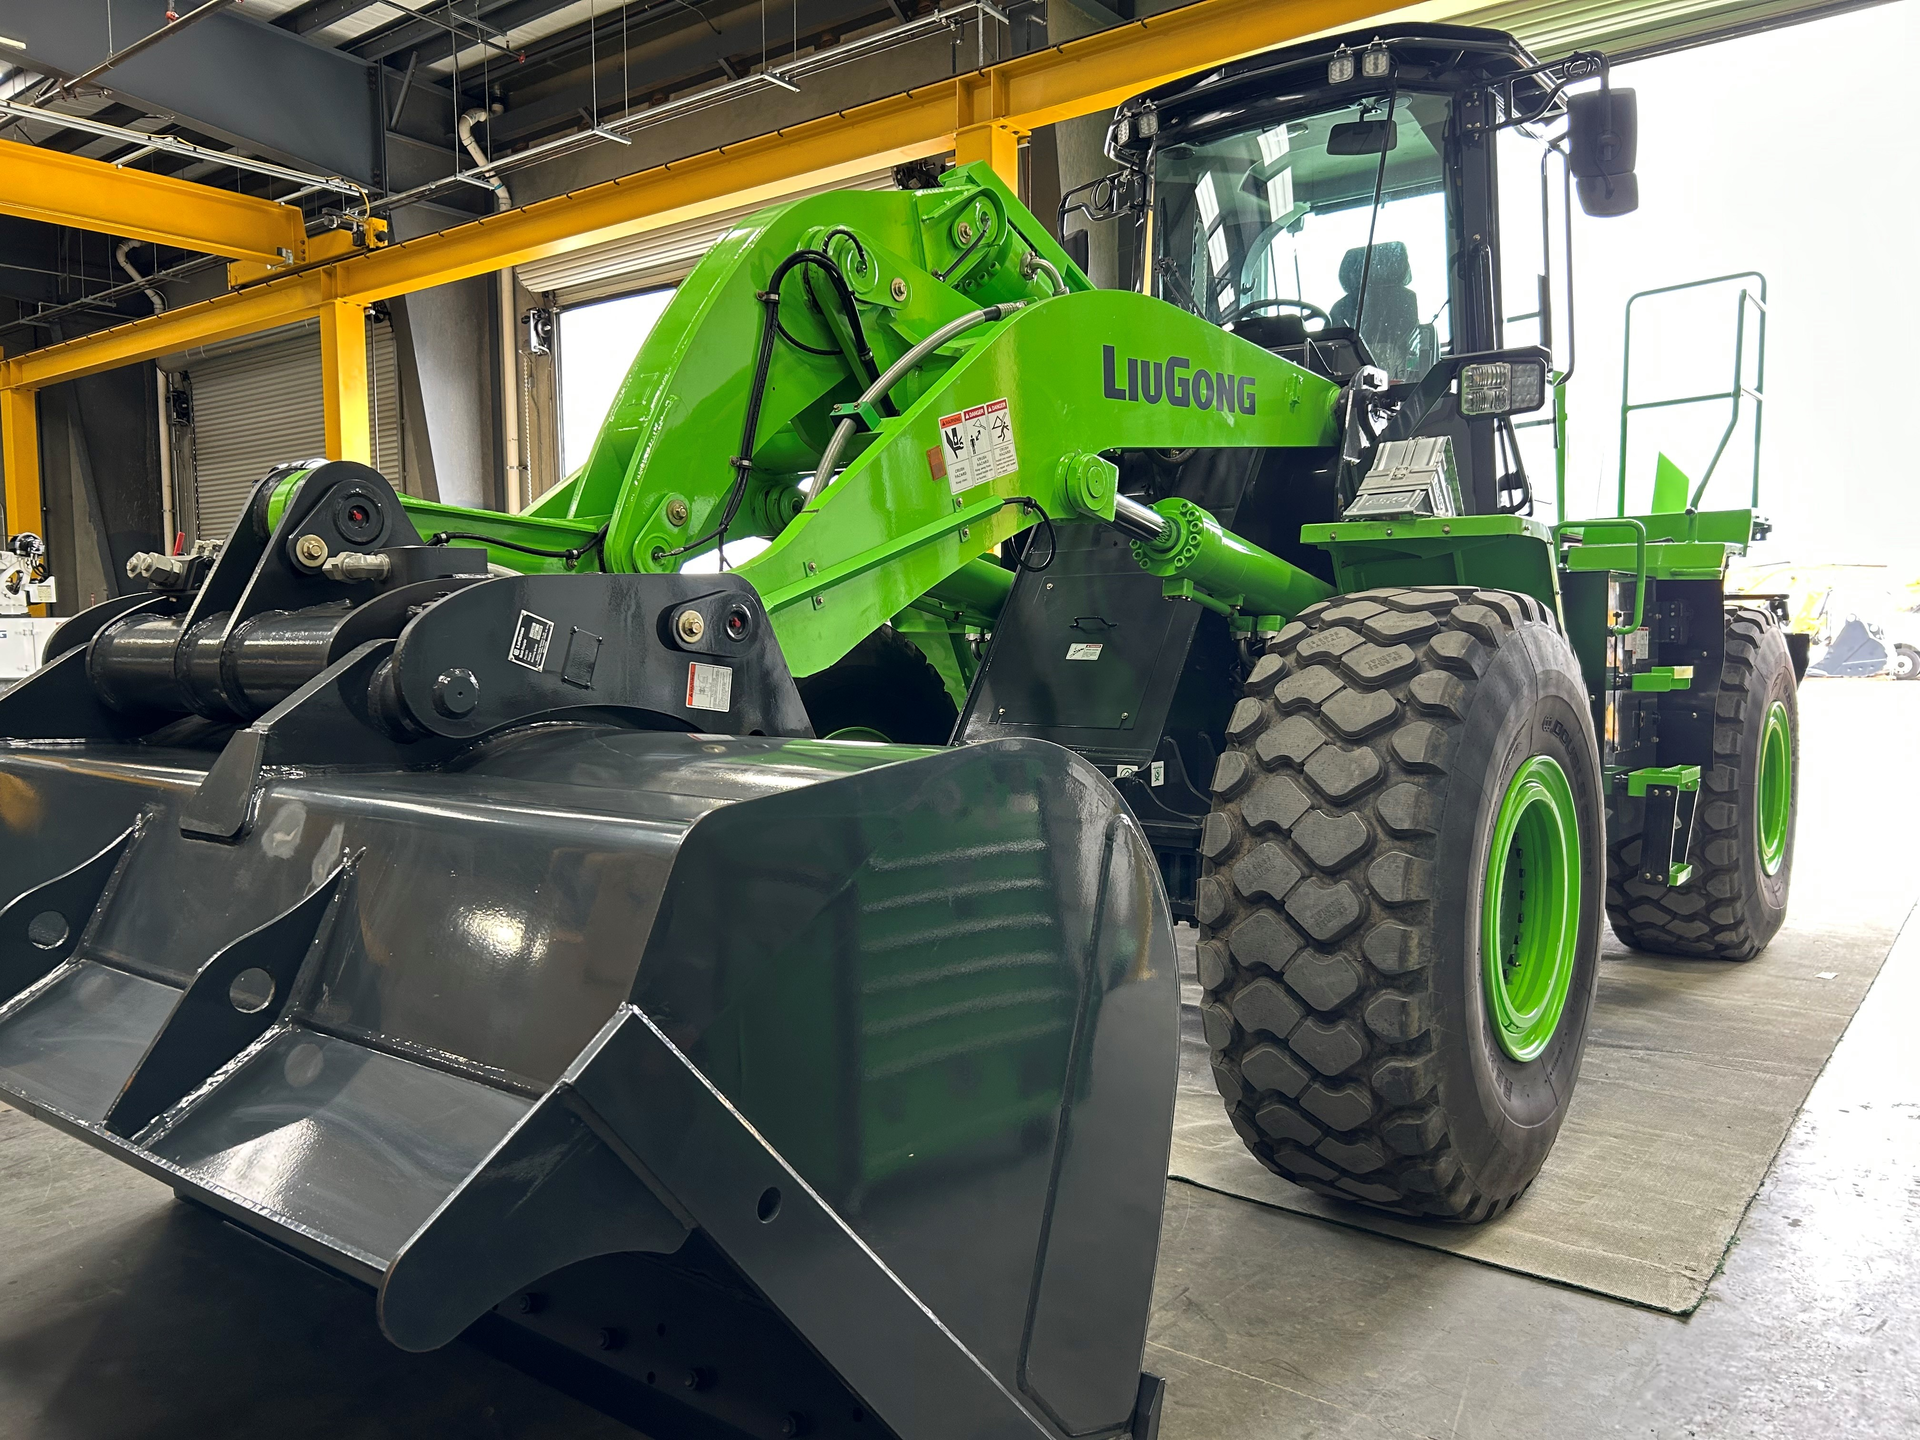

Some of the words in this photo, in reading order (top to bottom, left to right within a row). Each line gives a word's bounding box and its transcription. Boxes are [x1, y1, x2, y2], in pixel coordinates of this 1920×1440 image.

[992, 402, 1006, 410] DANGER
[969, 408, 984, 417] DANGER
[945, 416, 962, 424] WARNING
